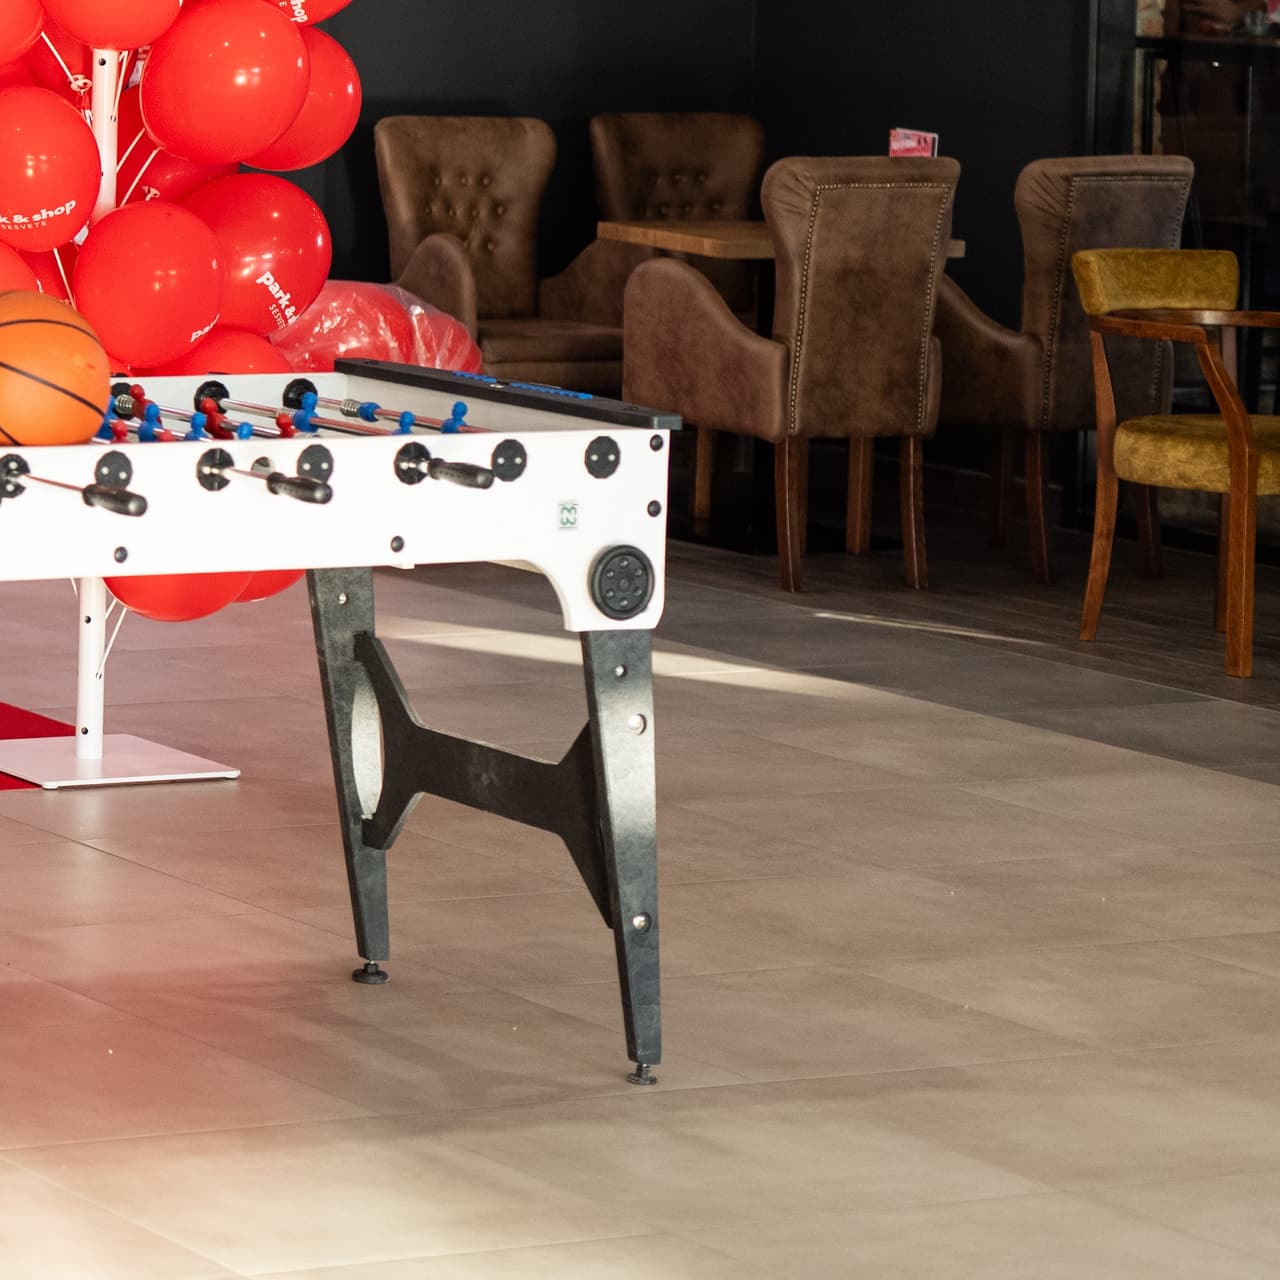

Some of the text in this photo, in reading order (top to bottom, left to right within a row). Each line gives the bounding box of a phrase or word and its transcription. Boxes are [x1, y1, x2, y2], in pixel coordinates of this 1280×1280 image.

[12, 214, 29, 223] &
[32, 200, 76, 222] shop
[0, 221, 47, 231] SESVETE
[255, 270, 291, 310] park
